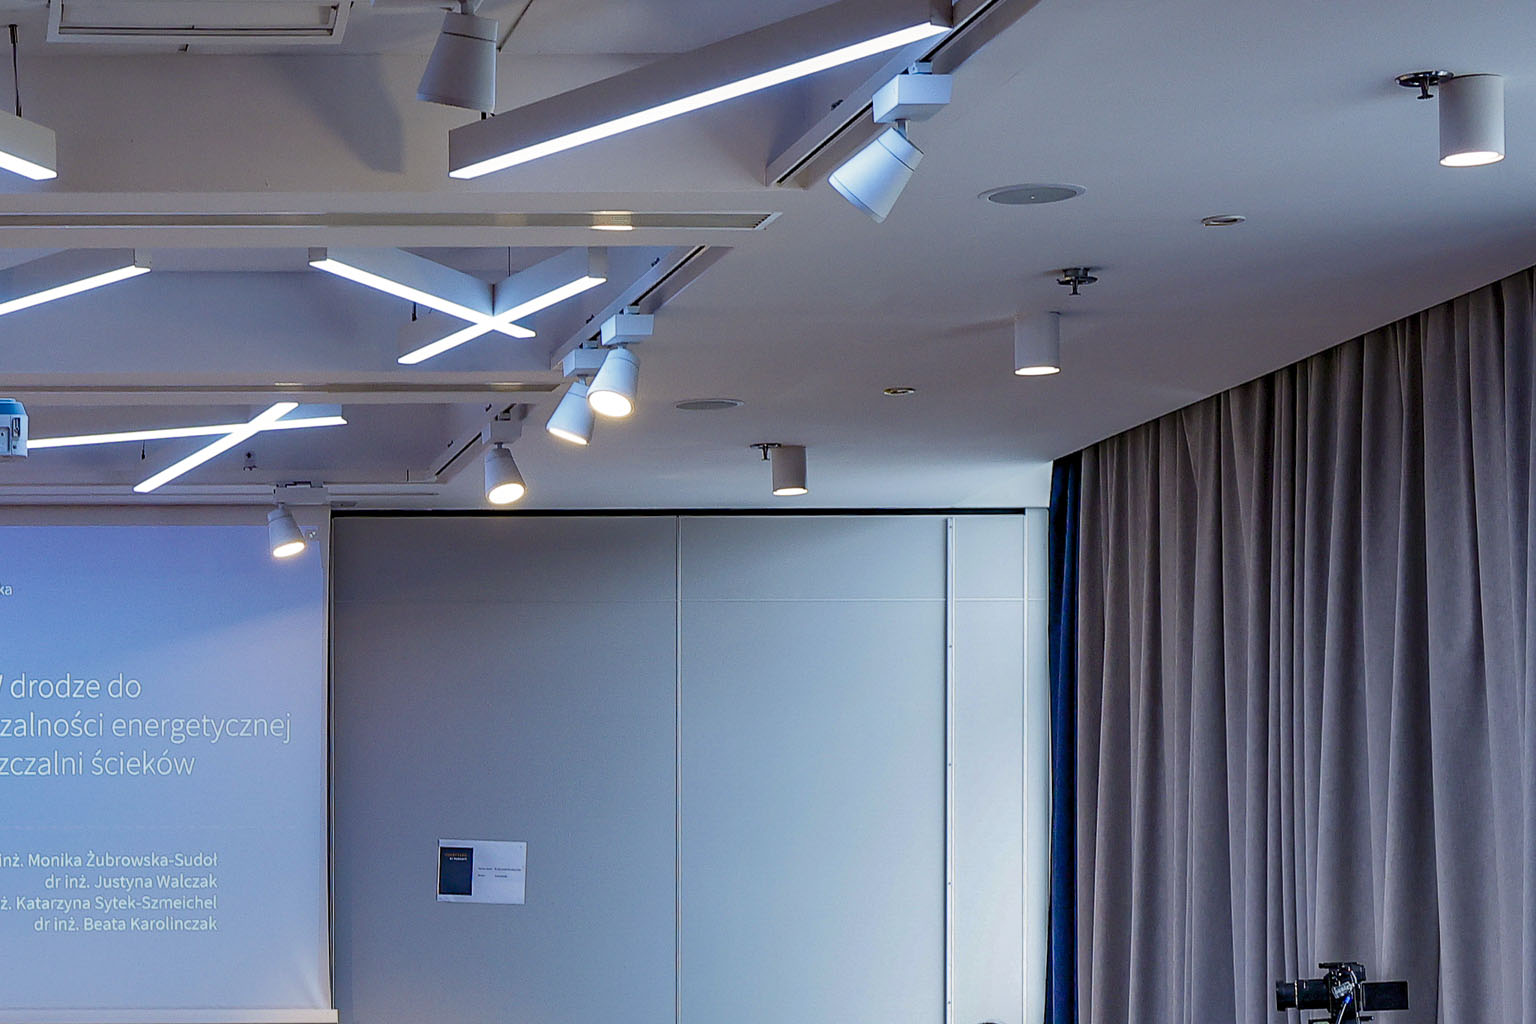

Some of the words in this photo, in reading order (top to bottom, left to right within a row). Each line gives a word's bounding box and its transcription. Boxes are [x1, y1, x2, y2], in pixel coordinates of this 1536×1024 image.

[10, 672, 100, 699] drodze
[108, 672, 141, 699] do
[112, 712, 291, 744] energetycznej
[91, 750, 195, 776] ścieków
[28, 853, 81, 867] Monika
[86, 850, 218, 868] Żubrowska-Sudoł
[45, 874, 61, 889] dr
[65, 874, 90, 889] inż.
[94, 875, 152, 892] Justyna
[156, 874, 218, 889] Walczak
[16, 896, 91, 913] Katarzyna
[95, 895, 218, 913] Sytek-Szmeichel
[34, 917, 50, 931] dr
[54, 917, 79, 932] inż.
[84, 917, 126, 931] Beata
[131, 917, 218, 931] Karolinczak
